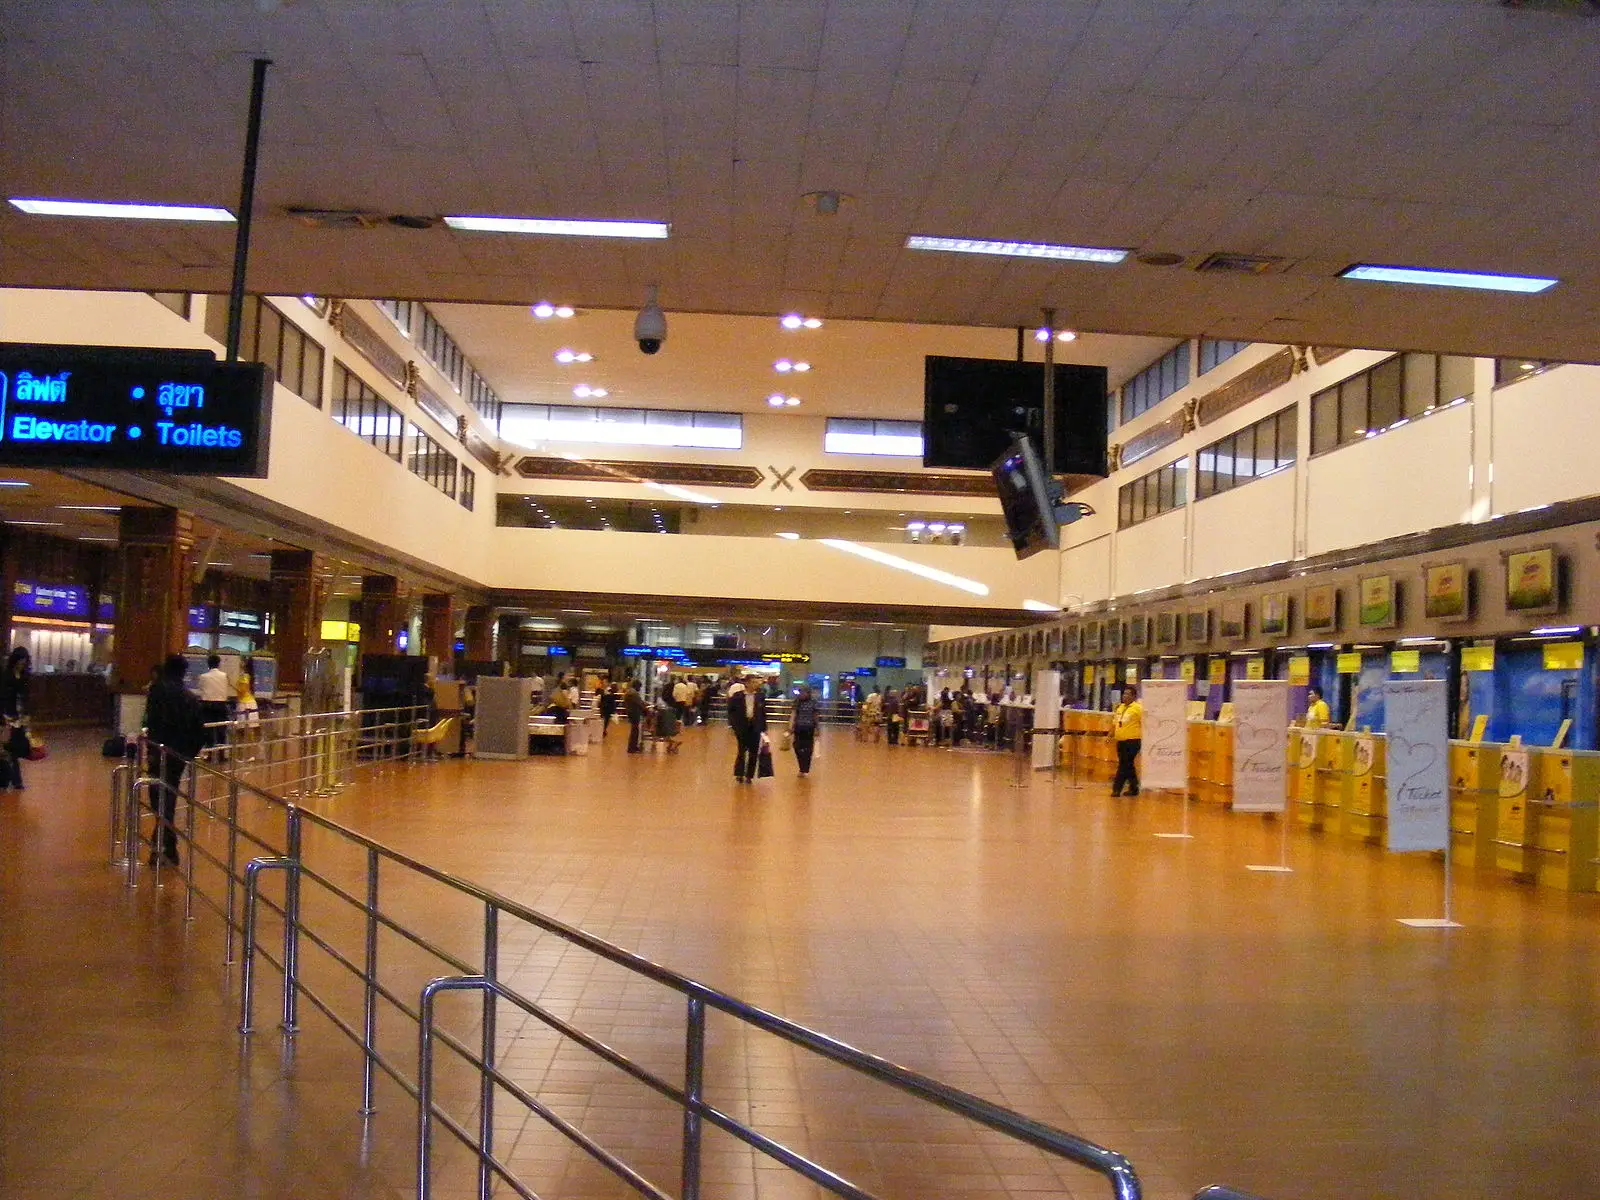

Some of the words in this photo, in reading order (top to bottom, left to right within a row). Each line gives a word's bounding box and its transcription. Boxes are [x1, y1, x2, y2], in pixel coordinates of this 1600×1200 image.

[157, 382, 205, 416] สุขา
[12, 416, 116, 442] Elevator
[156, 422, 242, 447] Toilets
